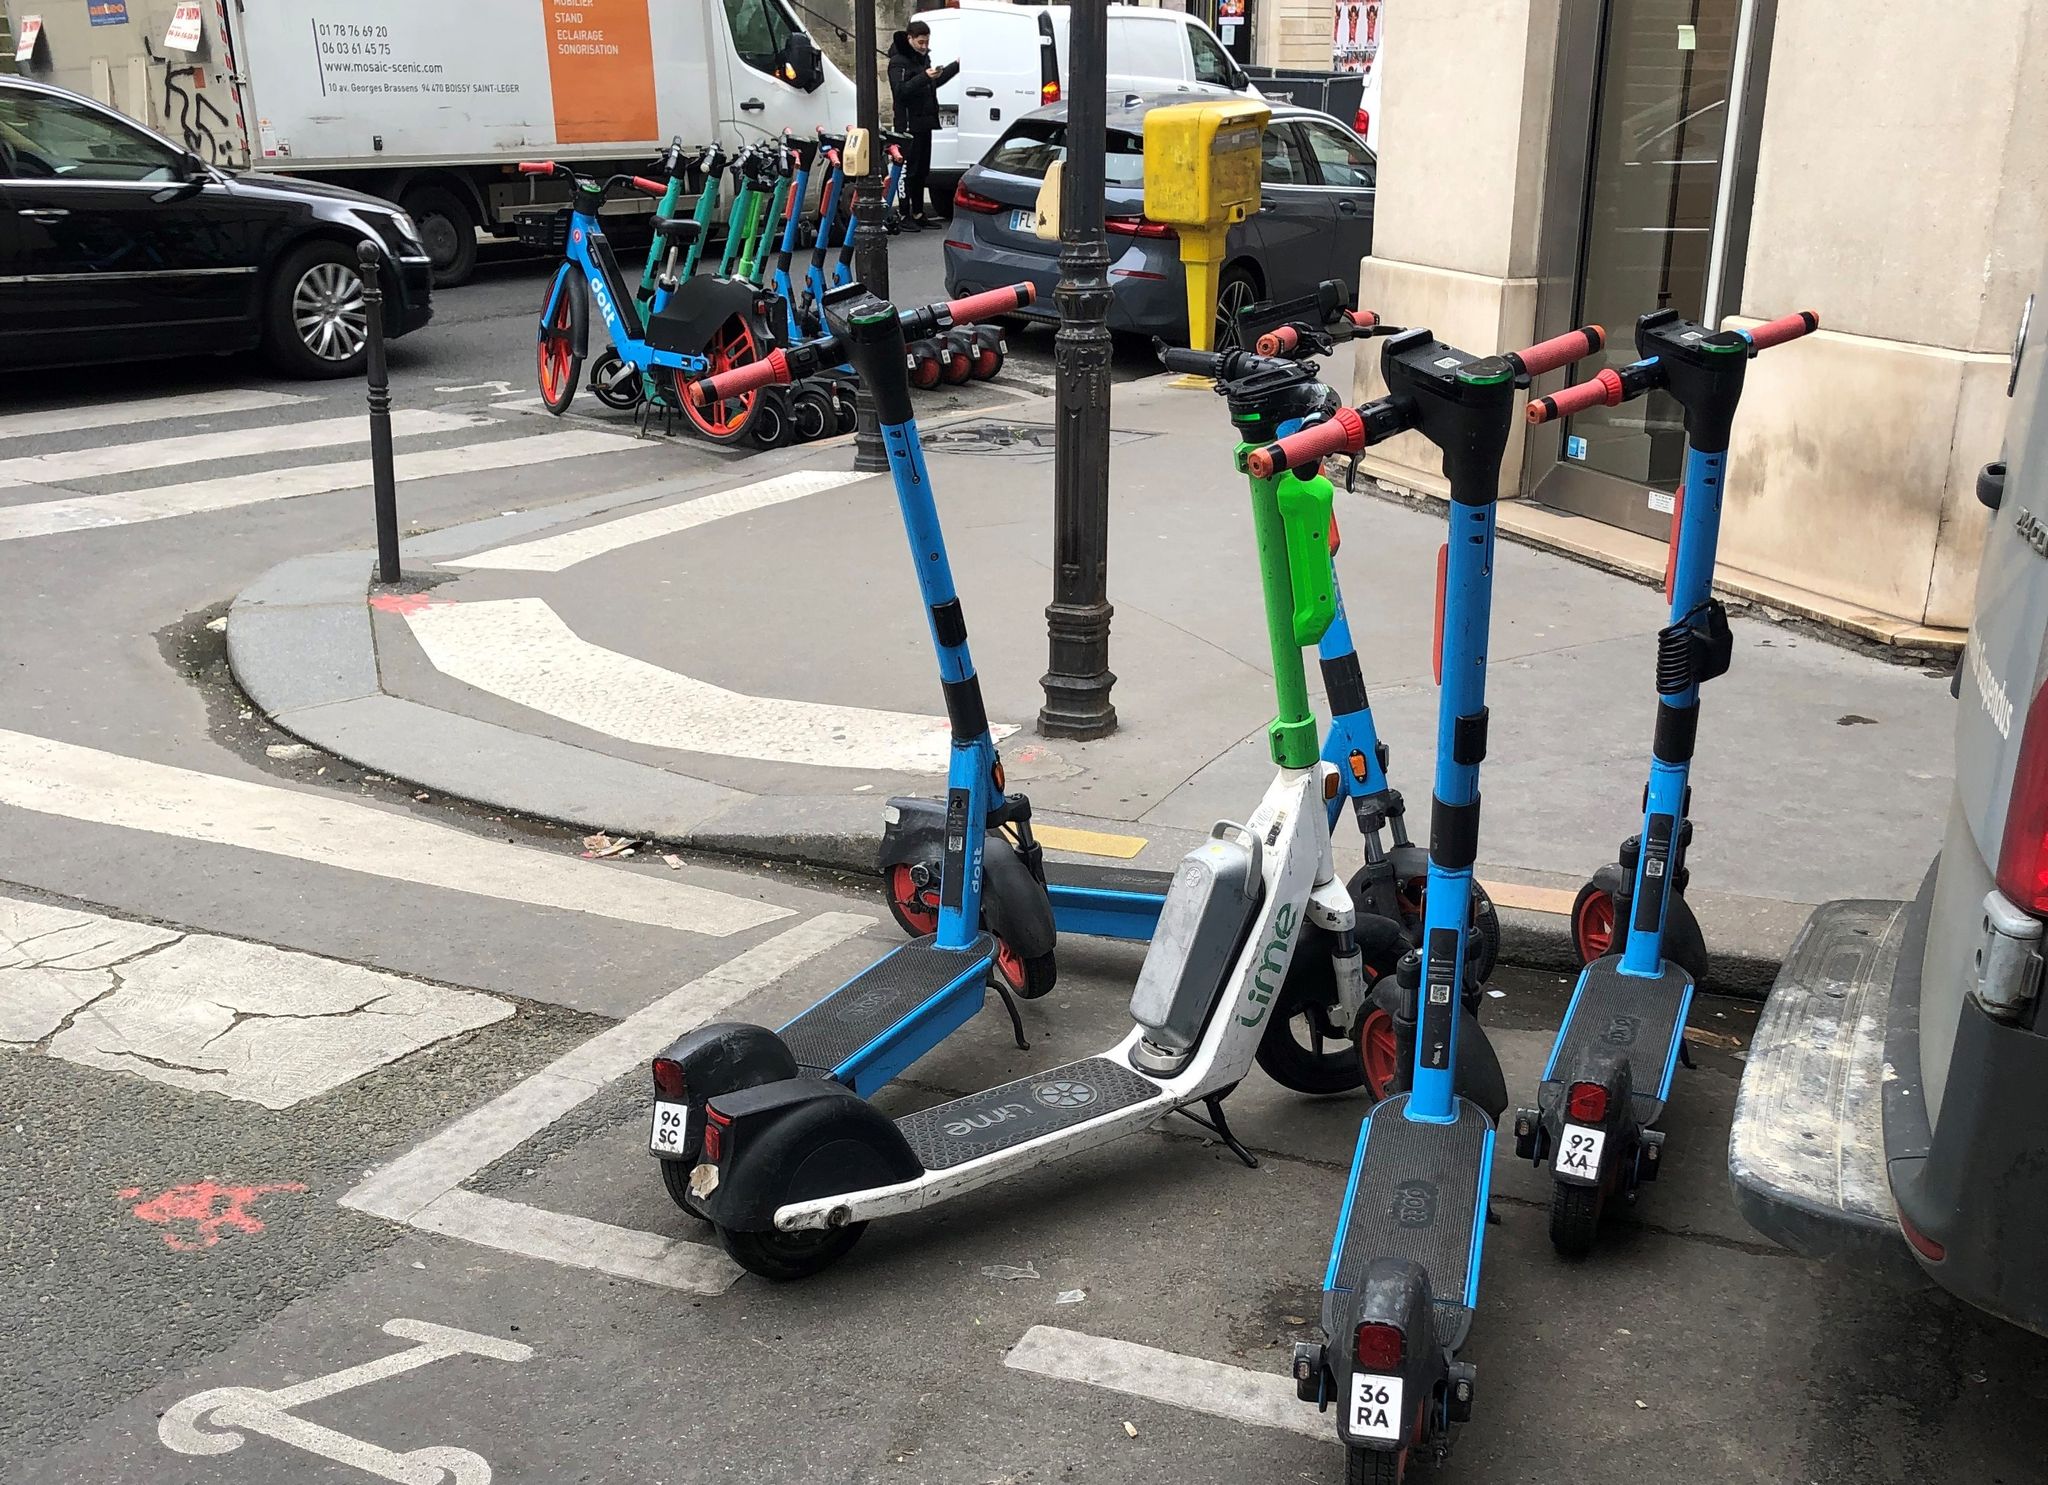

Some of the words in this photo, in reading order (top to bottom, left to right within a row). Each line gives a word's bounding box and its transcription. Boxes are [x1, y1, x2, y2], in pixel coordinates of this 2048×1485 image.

[554, 12, 584, 24] STAND
[319, 24, 331, 36] 01
[333, 24, 346, 37] 78
[347, 24, 360, 37] 76
[362, 25, 373, 37] 69
[375, 26, 388, 38] 20
[556, 29, 604, 41] ECLAIRAGE
[321, 42, 335, 54] 06
[336, 42, 349, 54] 03
[351, 43, 361, 55] 61
[364, 43, 377, 55] 45
[378, 43, 391, 55] 75
[557, 43, 619, 55] SONORISATION
[324, 61, 443, 73] www.mosaic-scenic.com
[328, 83, 338, 92] 10
[339, 84, 350, 93] av.
[350, 83, 383, 94] Georges
[383, 83, 419, 93] Brassens
[421, 83, 430, 92] 94
[431, 83, 444, 93] 470
[445, 83, 471, 93] BOISSY
[472, 83, 520, 93] SAINT-LEGER
[591, 277, 616, 329] dott
[971, 846, 983, 894] dott
[1239, 902, 1298, 1028] Lime
[661, 1110, 681, 1127] 96
[943, 1102, 1036, 1137] Lime
[658, 1128, 678, 1145] SC
[1570, 1134, 1595, 1153] 92
[1562, 1150, 1589, 1171] XA
[1359, 1384, 1390, 1405] 36
[1356, 1406, 1389, 1428] RA
